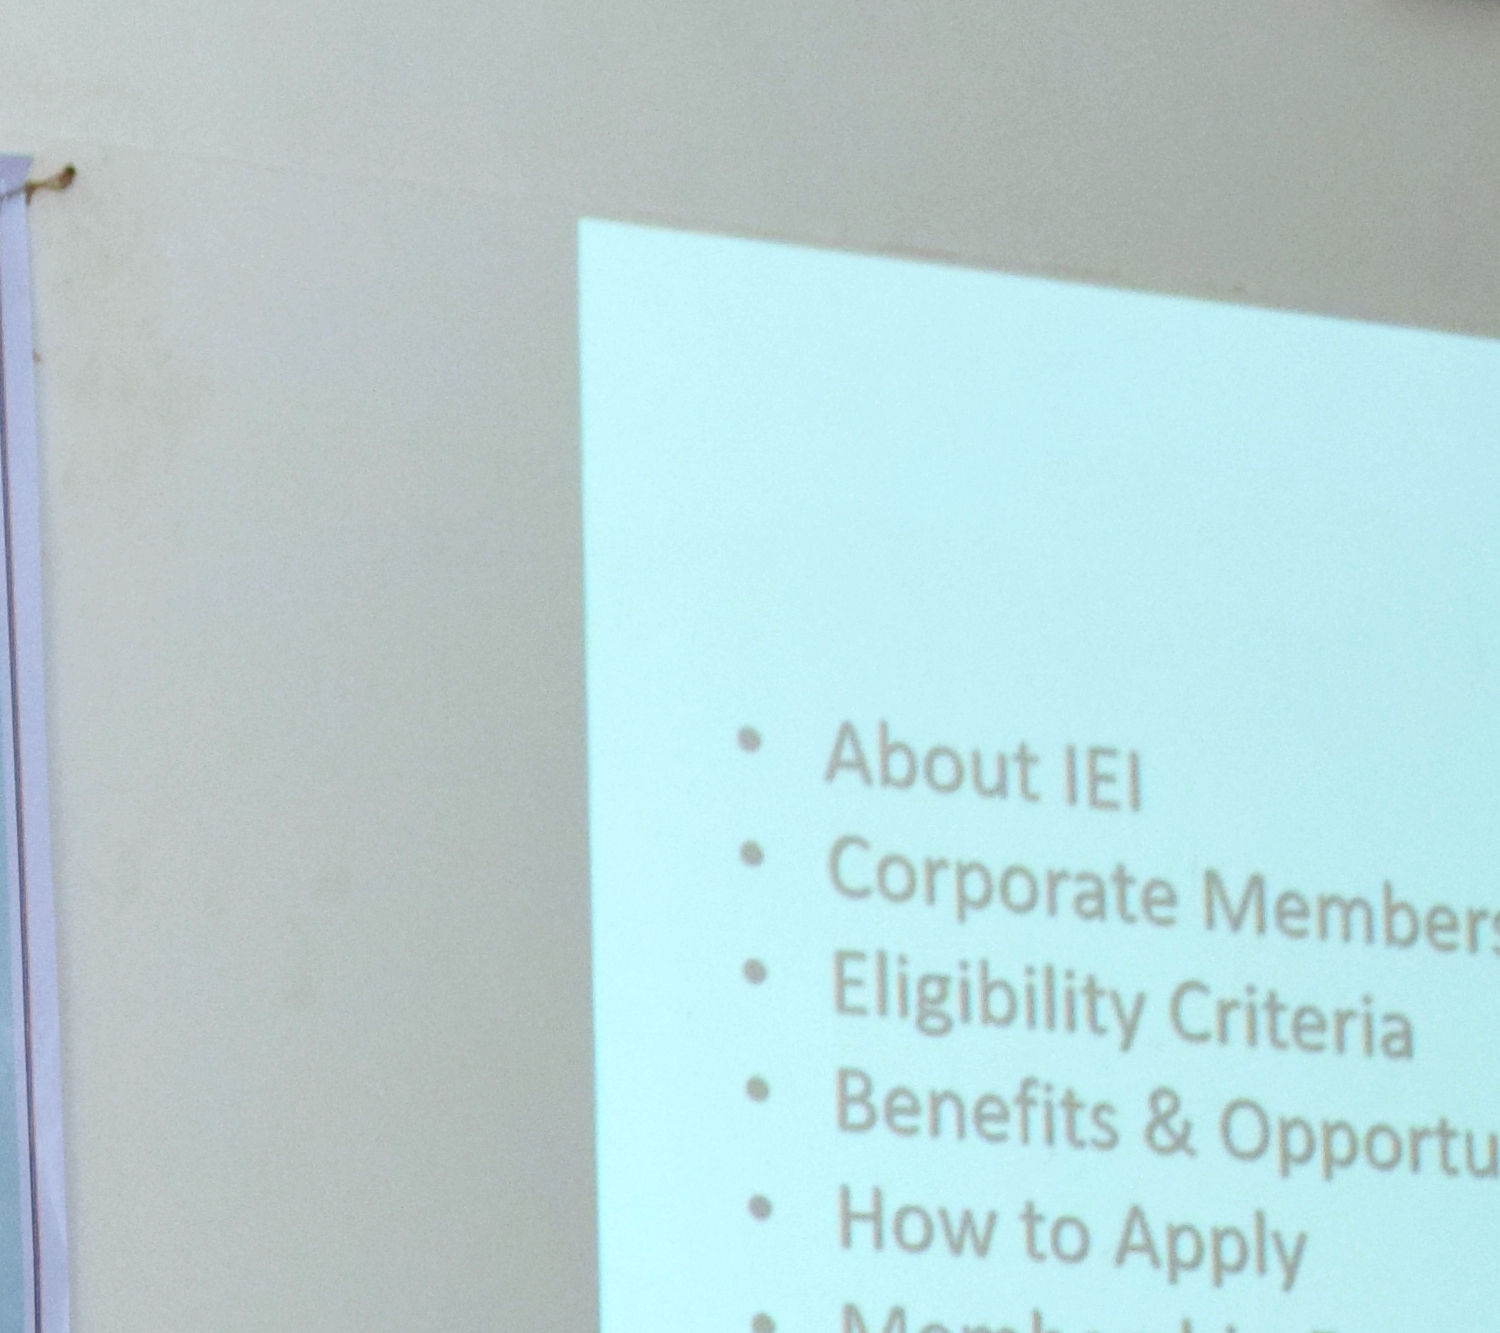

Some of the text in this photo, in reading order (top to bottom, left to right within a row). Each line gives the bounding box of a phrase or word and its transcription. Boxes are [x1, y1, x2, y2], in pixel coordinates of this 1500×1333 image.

[825, 719, 1144, 813] About IEI
[828, 832, 1179, 925] Corporate
[831, 949, 1414, 1061] Eligibility Criteria
[834, 1067, 1118, 1151] Benefits
[1144, 1088, 1195, 1156] &
[836, 1185, 1307, 1293] How to Apply
